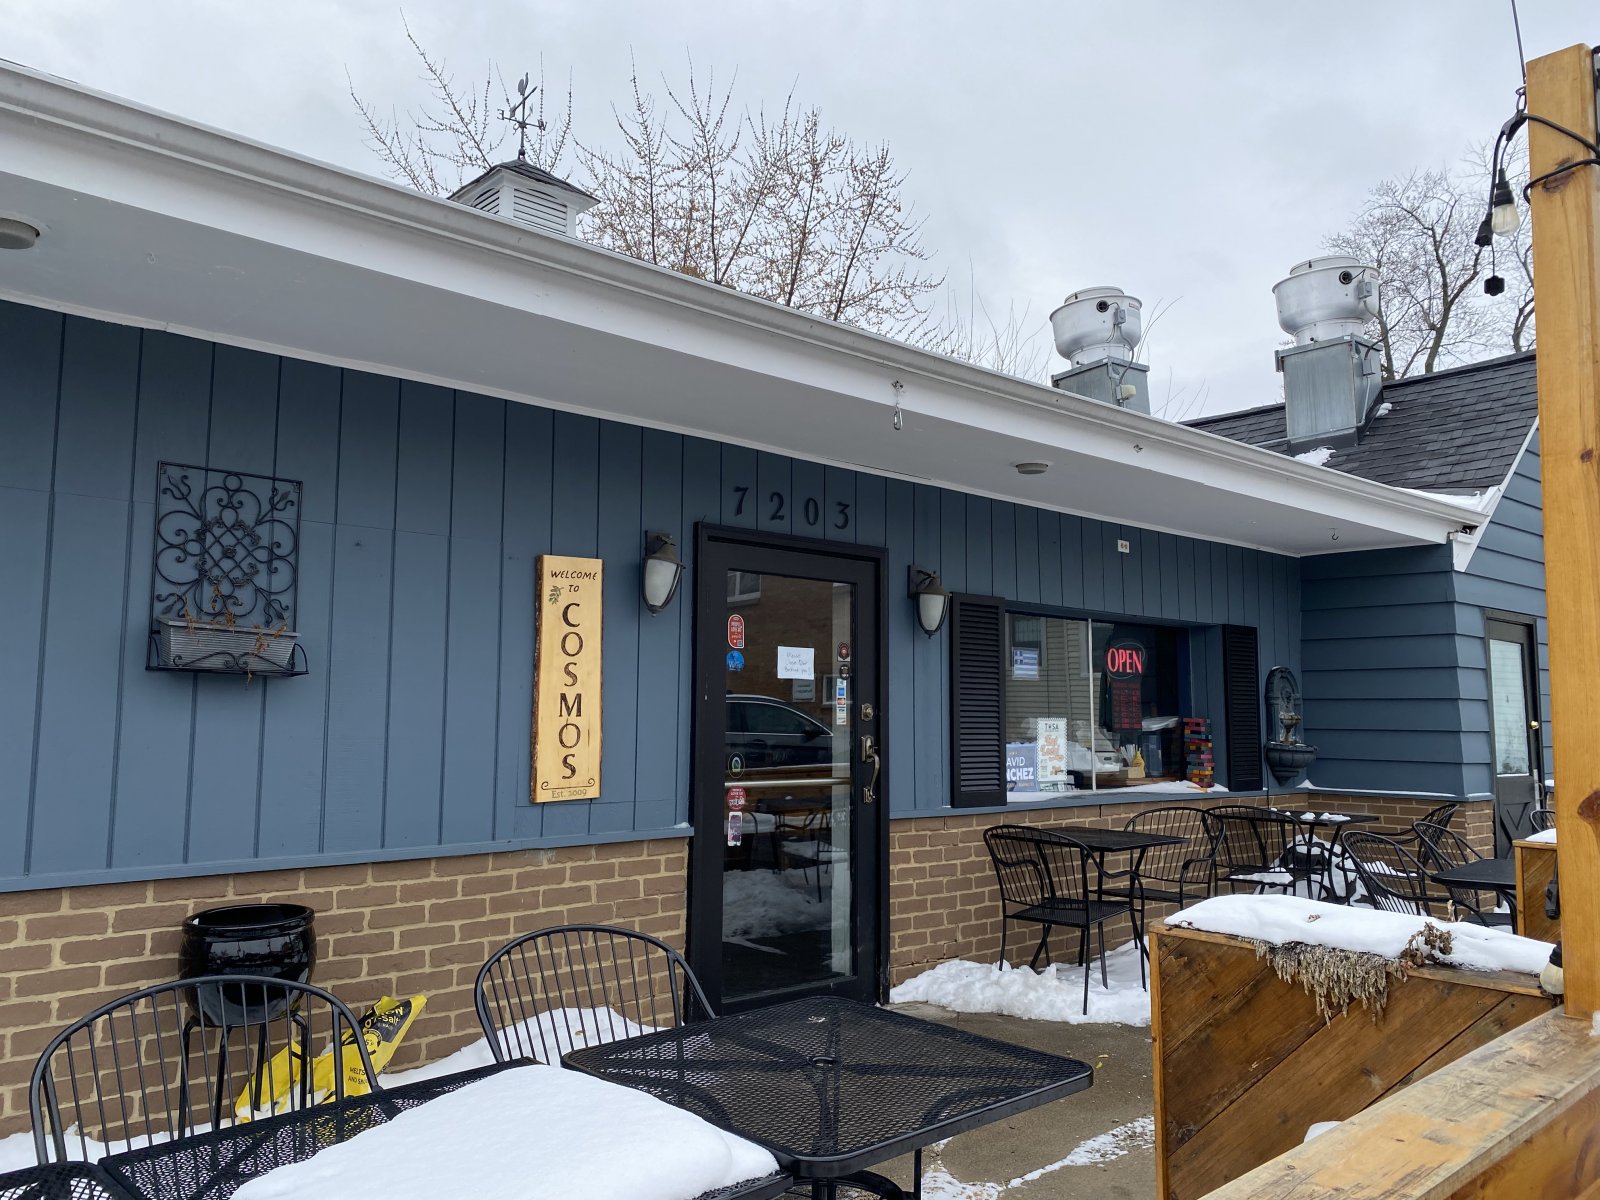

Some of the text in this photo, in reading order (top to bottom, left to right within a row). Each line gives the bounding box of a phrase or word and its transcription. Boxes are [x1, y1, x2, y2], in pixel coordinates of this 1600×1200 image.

[732, 485, 850, 530] 7203
[550, 569, 598, 581] WELCOME
[568, 584, 580, 593] TO
[1107, 647, 1142, 674] OPEN
[558, 602, 584, 780] COSMOS
[1006, 756, 1026, 767] AVID
[567, 789, 587, 797] 2009
